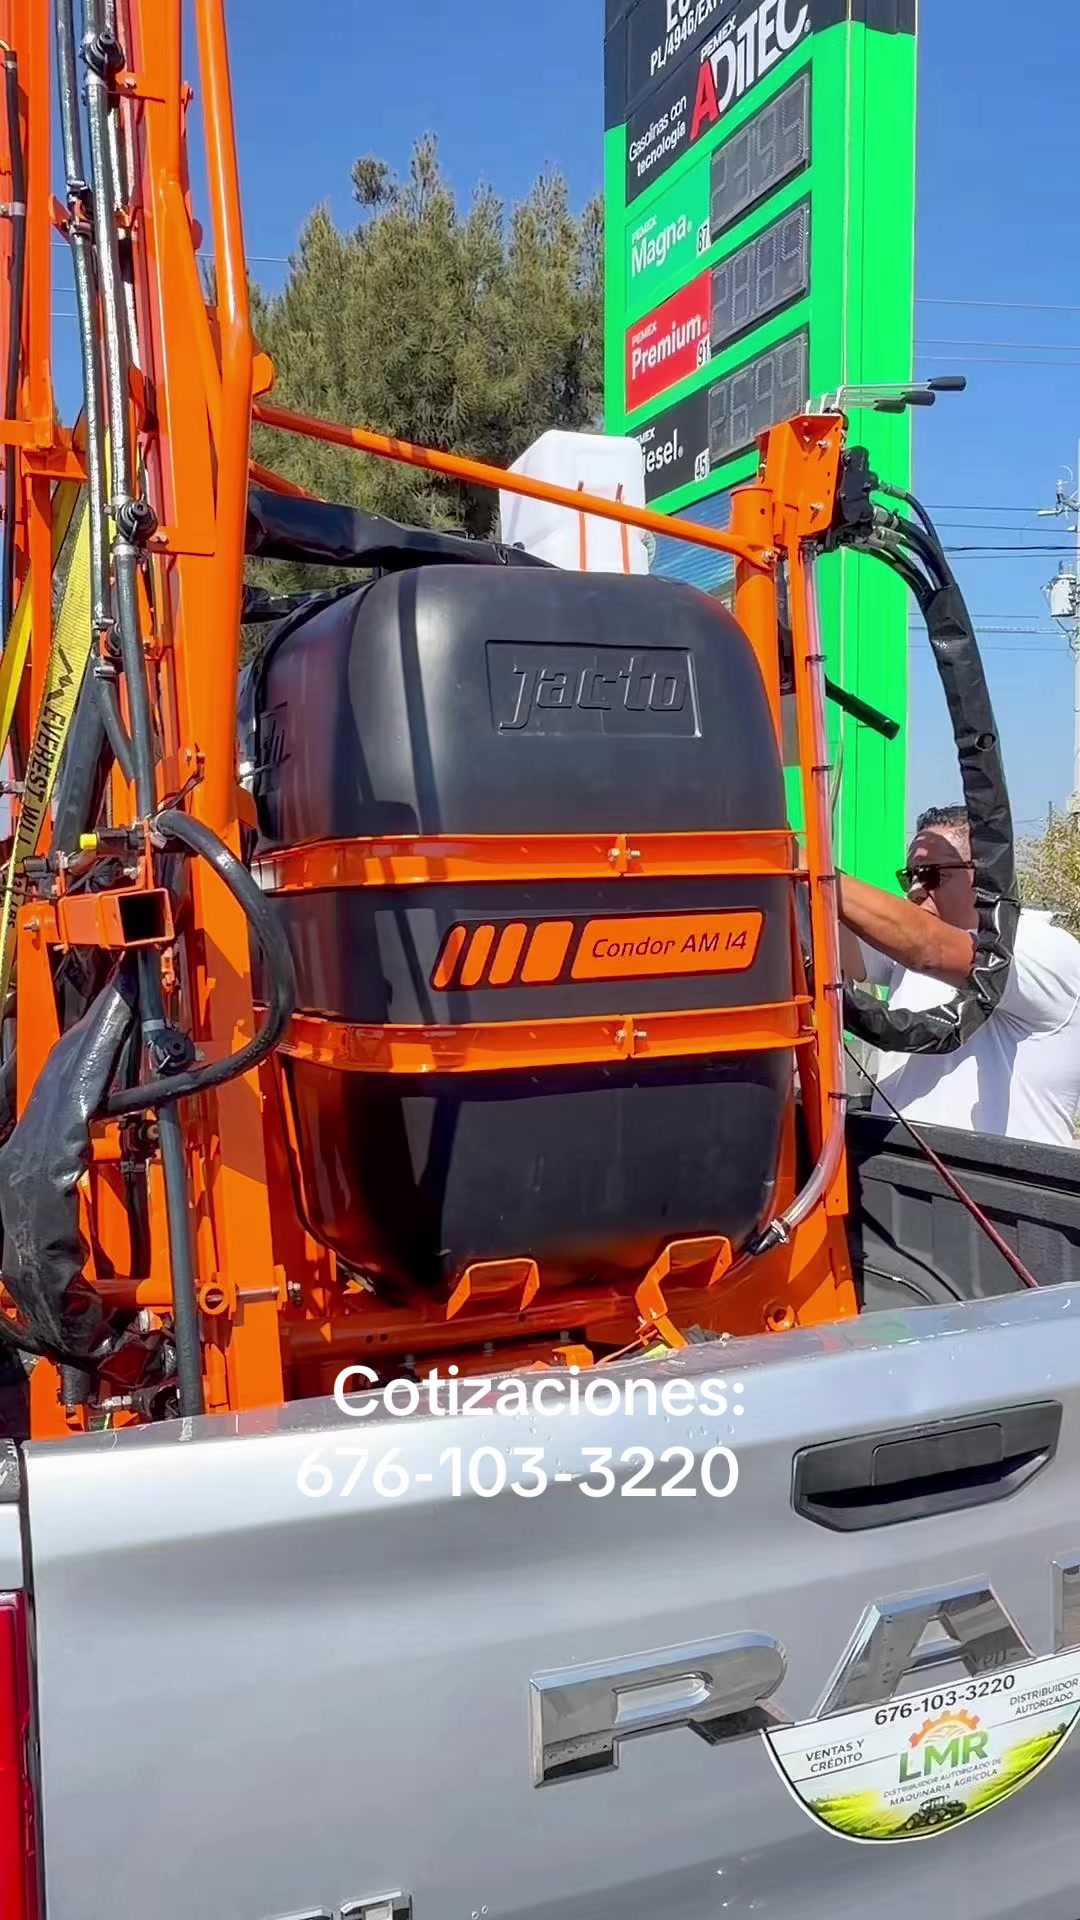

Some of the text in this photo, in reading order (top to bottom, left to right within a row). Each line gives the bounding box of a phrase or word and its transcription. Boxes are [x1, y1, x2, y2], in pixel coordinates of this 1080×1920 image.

[700, 15, 736, 62] PEMEX
[630, 95, 687, 162] Gasolinas con
[632, 214, 657, 246] PEMEX
[632, 214, 687, 278] Magna
[632, 320, 657, 347] PEMEX
[632, 314, 702, 380] Premium
[643, 428, 678, 474] iesel
[499, 655, 688, 730] jacto
[27, 706, 66, 803] EVEREST
[592, 936, 675, 958] Condor
[681, 933, 719, 953] AM
[529, 1560, 1080, 1789] RA
[1010, 1678, 1079, 1706] DISTRIBUIDOR
[874, 1674, 1015, 1726] 676-103-3220
[1015, 1691, 1073, 1715] AUTORIZADO
[806, 1738, 865, 1761] VENTAS Y
[810, 1752, 863, 1772] CRÉDITO
[898, 1728, 990, 1783] LMR
[883, 1776, 939, 1798] DISTRIBUIDOR
[940, 1761, 990, 1782] AUTORIZADO
[890, 1783, 951, 1806] MAQUINARIA
